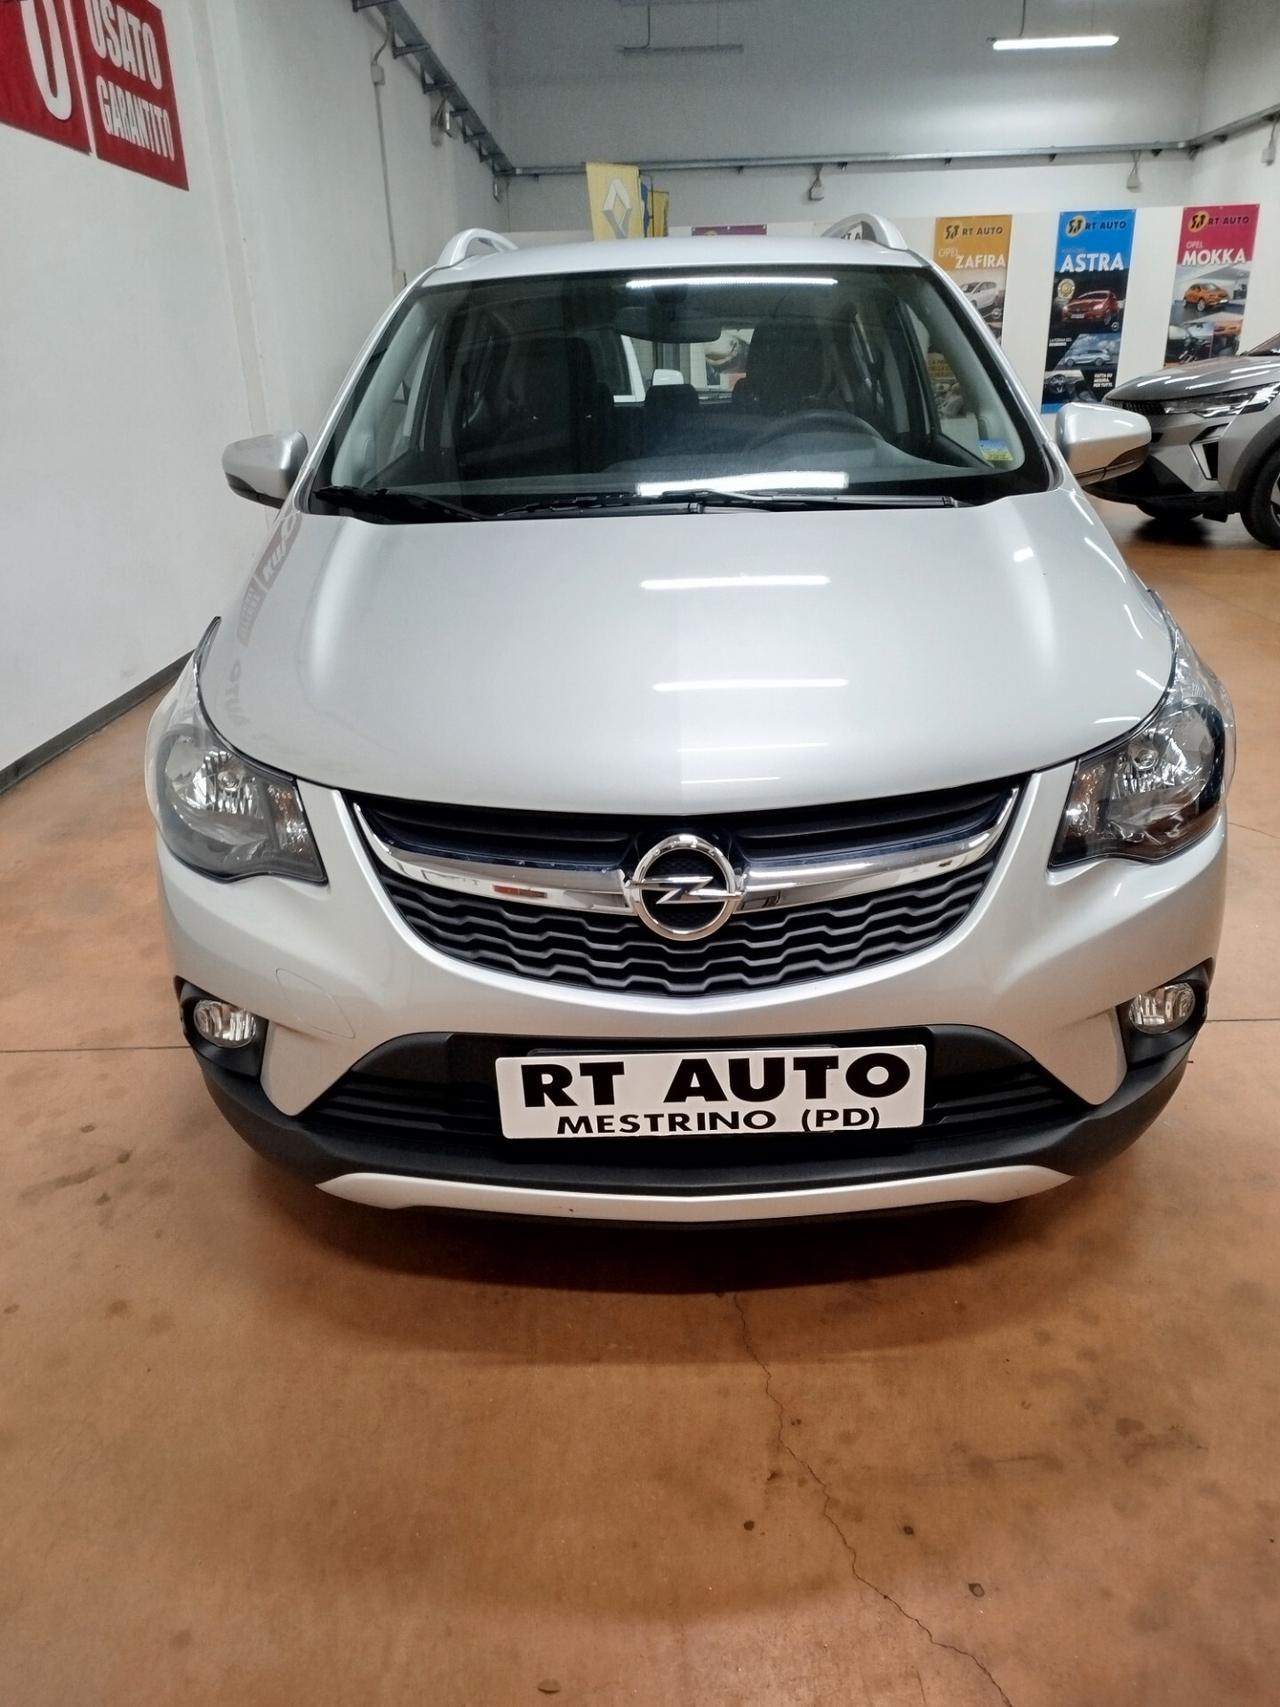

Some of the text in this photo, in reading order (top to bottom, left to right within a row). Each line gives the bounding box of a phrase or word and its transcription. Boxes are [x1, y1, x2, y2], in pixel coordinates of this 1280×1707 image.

[84, 0, 163, 91] USATO
[96, 75, 175, 161] GARANTITO
[962, 226, 1004, 236] RT AUTO
[1085, 220, 1127, 231] RT AUTO
[1208, 216, 1250, 226] RT AUTO
[954, 253, 1007, 269] ZAFIRA
[1059, 252, 1124, 273] ASTRA
[1182, 247, 1247, 266] MOKKA
[520, 1052, 911, 1108] RT AUTO
[556, 1106, 880, 1135] MESTRINO (PD)
